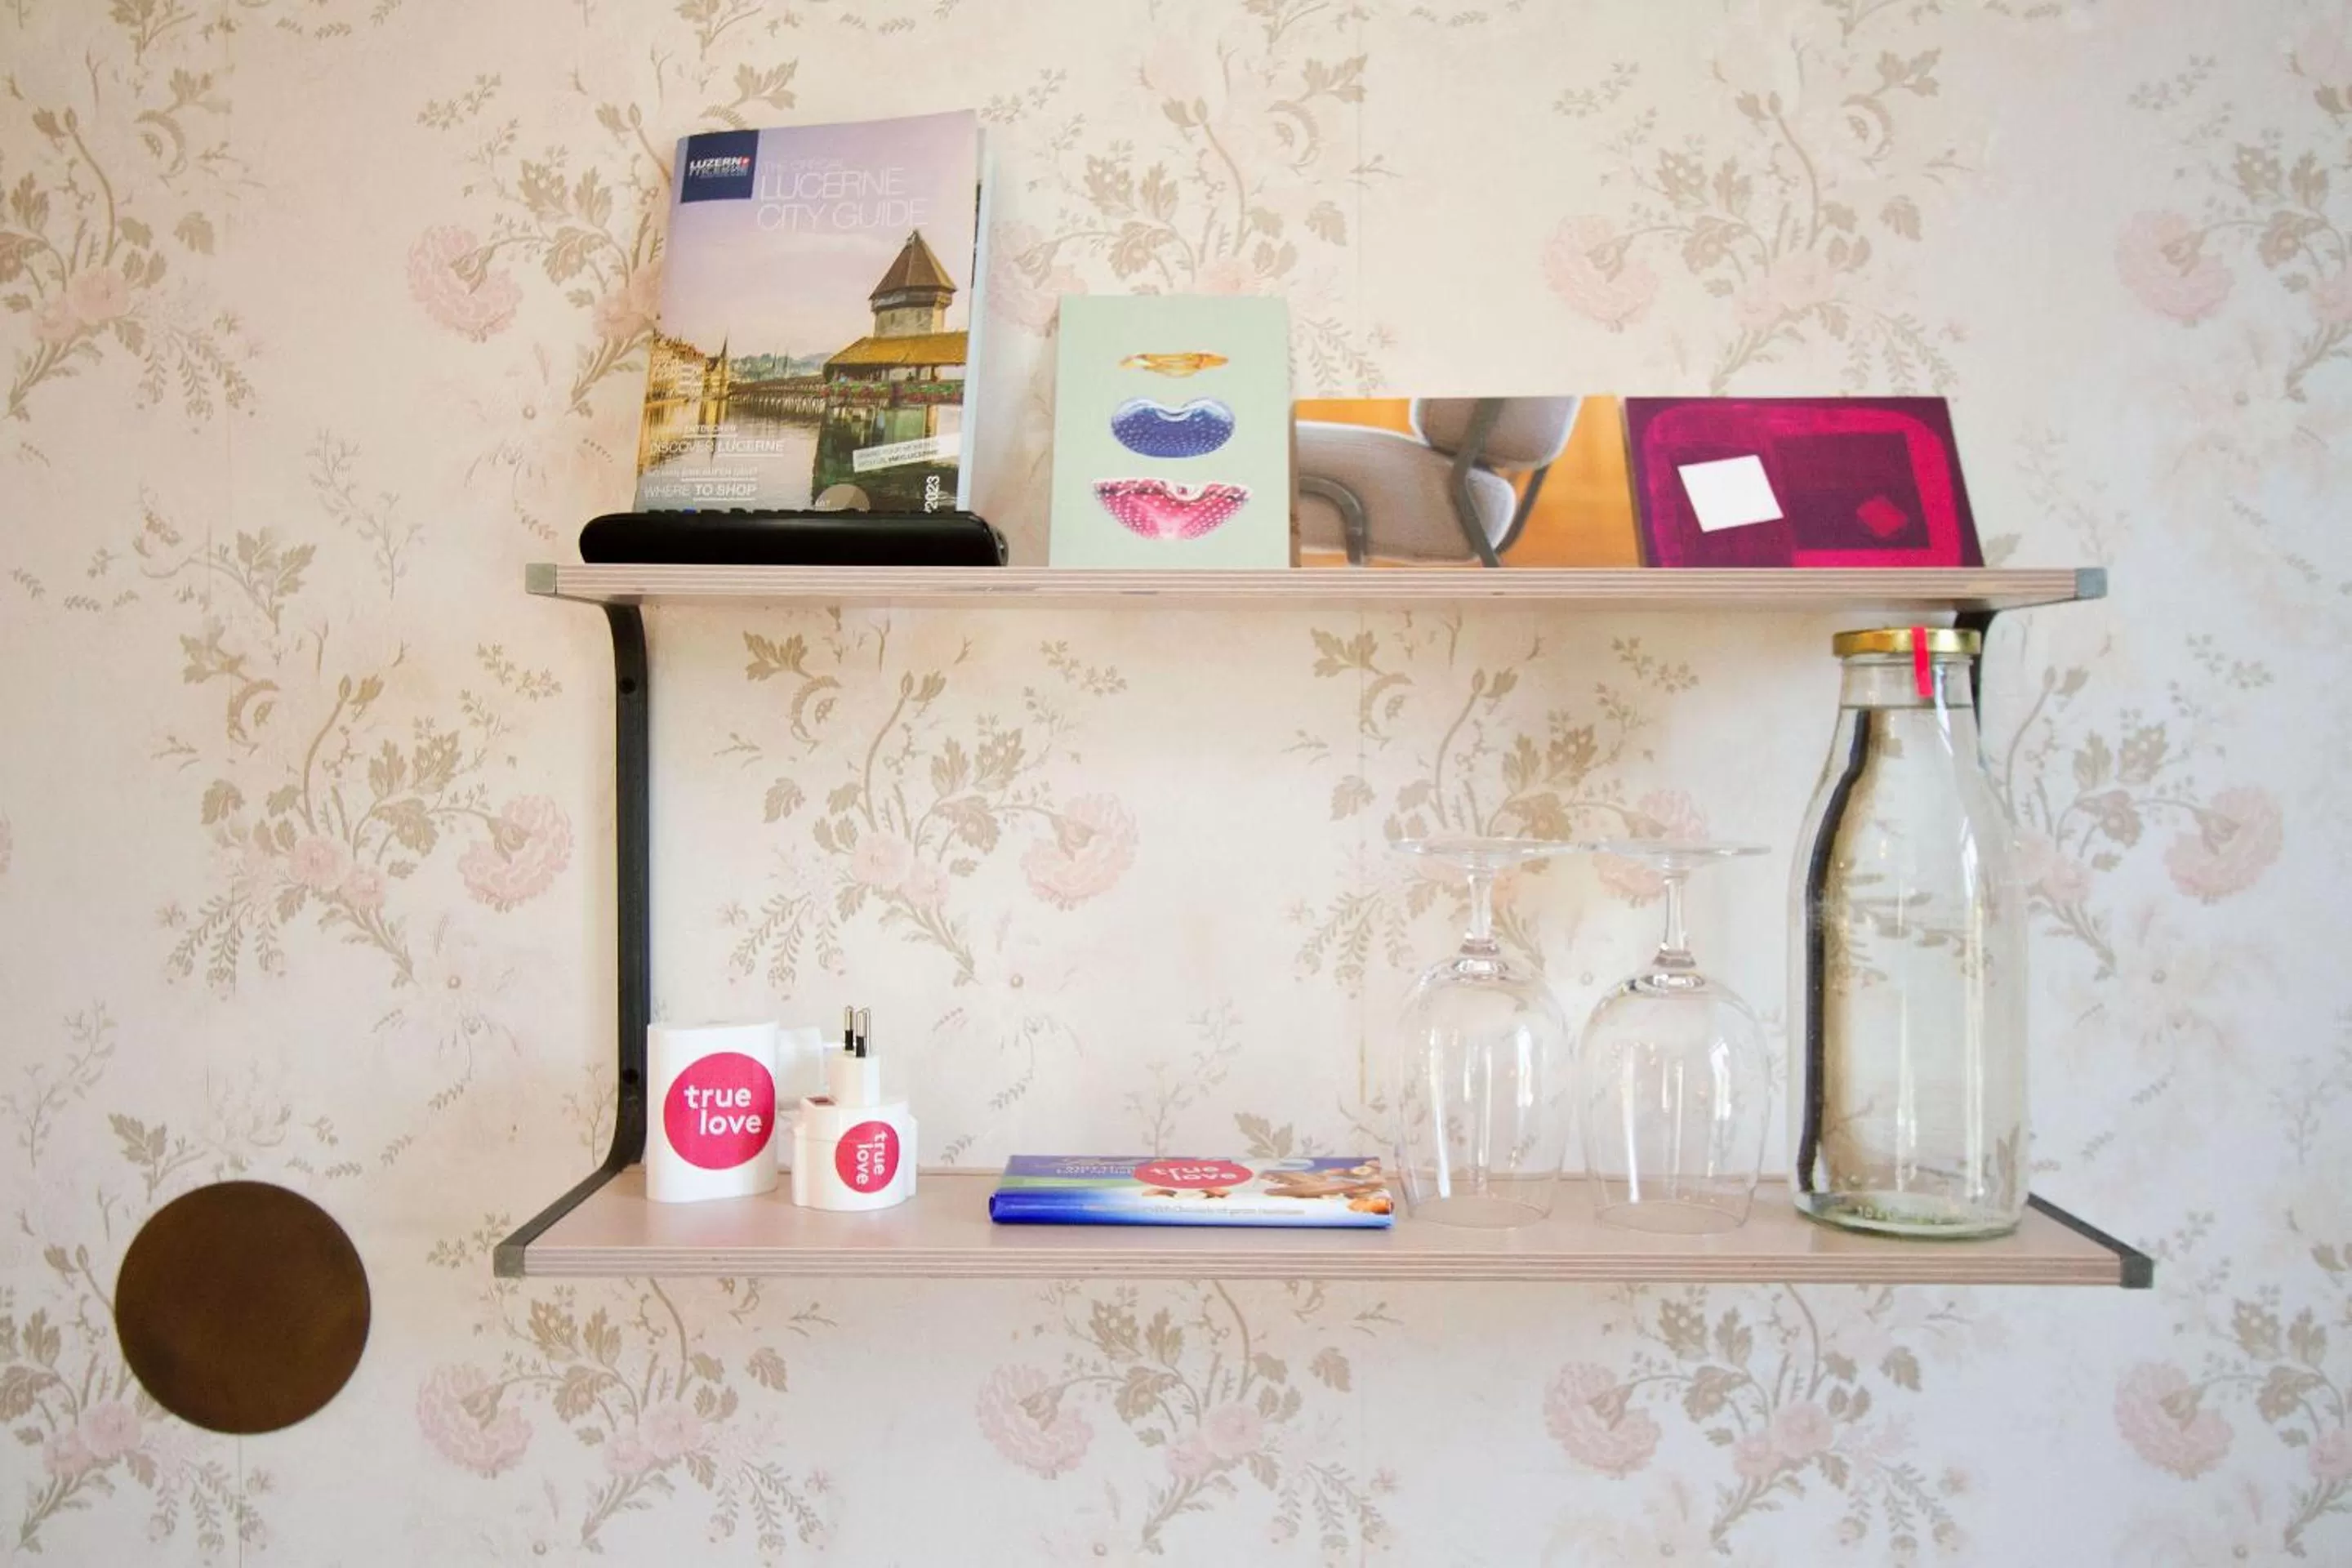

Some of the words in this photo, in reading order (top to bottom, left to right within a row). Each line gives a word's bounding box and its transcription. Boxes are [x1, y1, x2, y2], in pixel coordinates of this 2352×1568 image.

[760, 166, 906, 202] LUCERNE
[756, 203, 826, 232] CITY
[832, 198, 929, 230] GUIDE
[649, 439, 714, 454] DISCOVER
[717, 439, 785, 452] LUCERNE
[644, 483, 691, 498] WHERE
[695, 483, 714, 497] TO
[715, 482, 756, 497] SHOP
[924, 474, 940, 514] 2023
[684, 1085, 751, 1109] true
[699, 1110, 762, 1136] love
[856, 1143, 872, 1186] love
[873, 1129, 887, 1176] true
[1149, 1166, 1219, 1176] true
[1174, 1170, 1239, 1181] love
